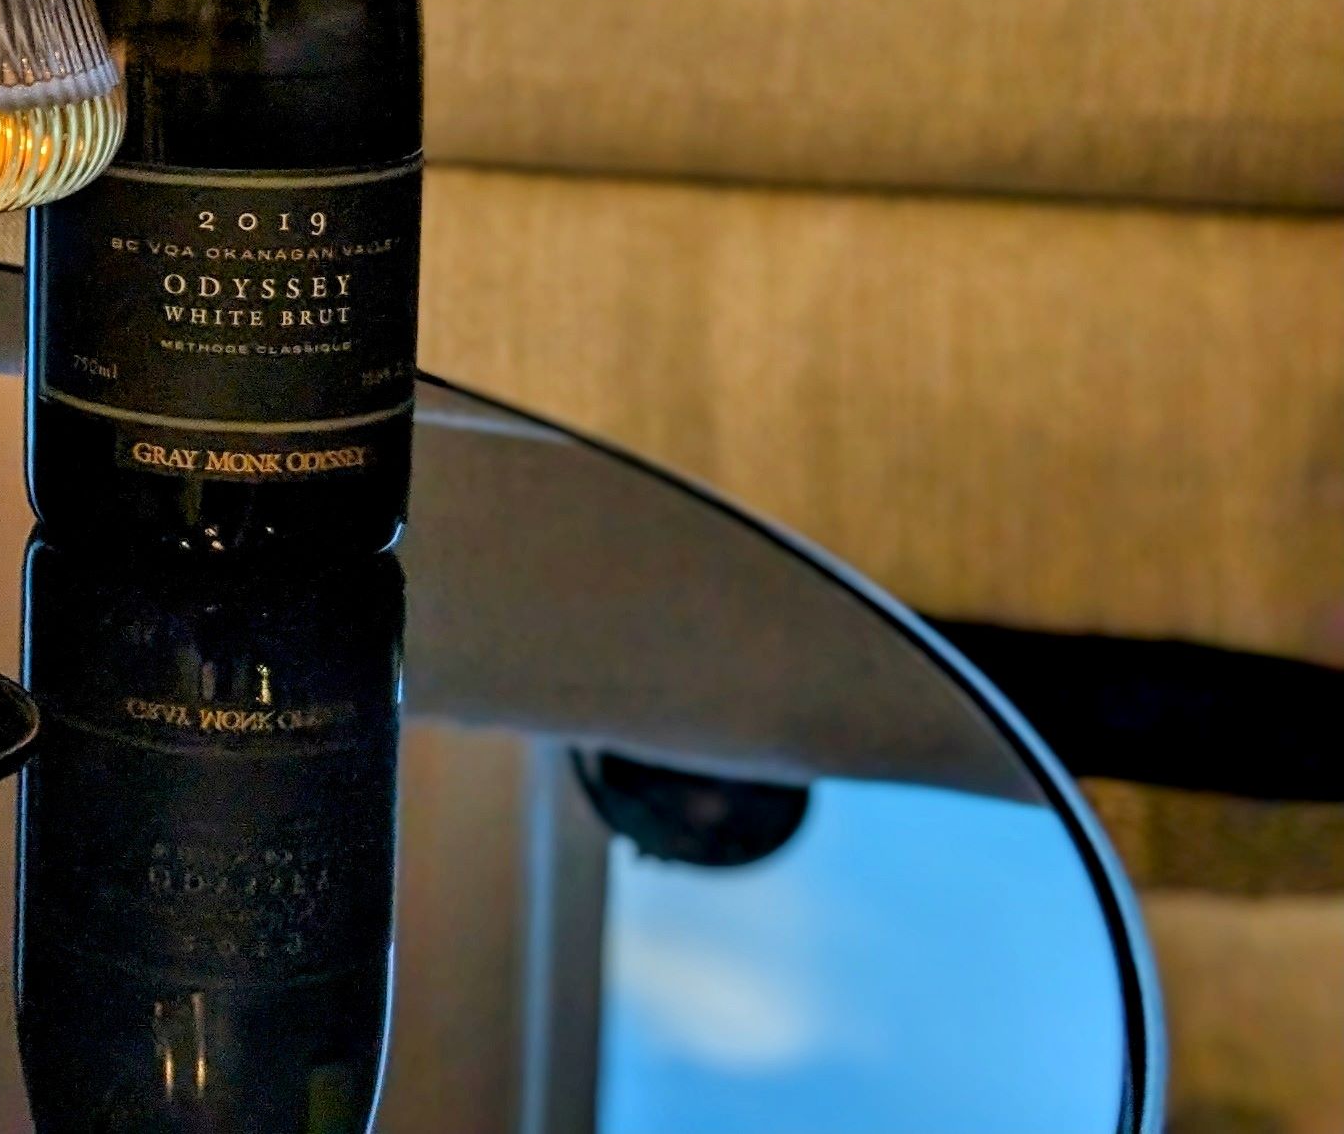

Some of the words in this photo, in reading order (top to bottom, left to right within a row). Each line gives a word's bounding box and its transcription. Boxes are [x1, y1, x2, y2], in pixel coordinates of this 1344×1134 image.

[197, 211, 326, 236] 2019
[111, 237, 140, 252] BC
[149, 240, 196, 258] VQA
[205, 246, 334, 262] OKANAGAN
[163, 273, 351, 300] ODYSSEY
[164, 305, 263, 326] WHITE
[280, 307, 351, 326] BRUT
[132, 442, 199, 469] GRAY
[204, 450, 282, 473] MONK
